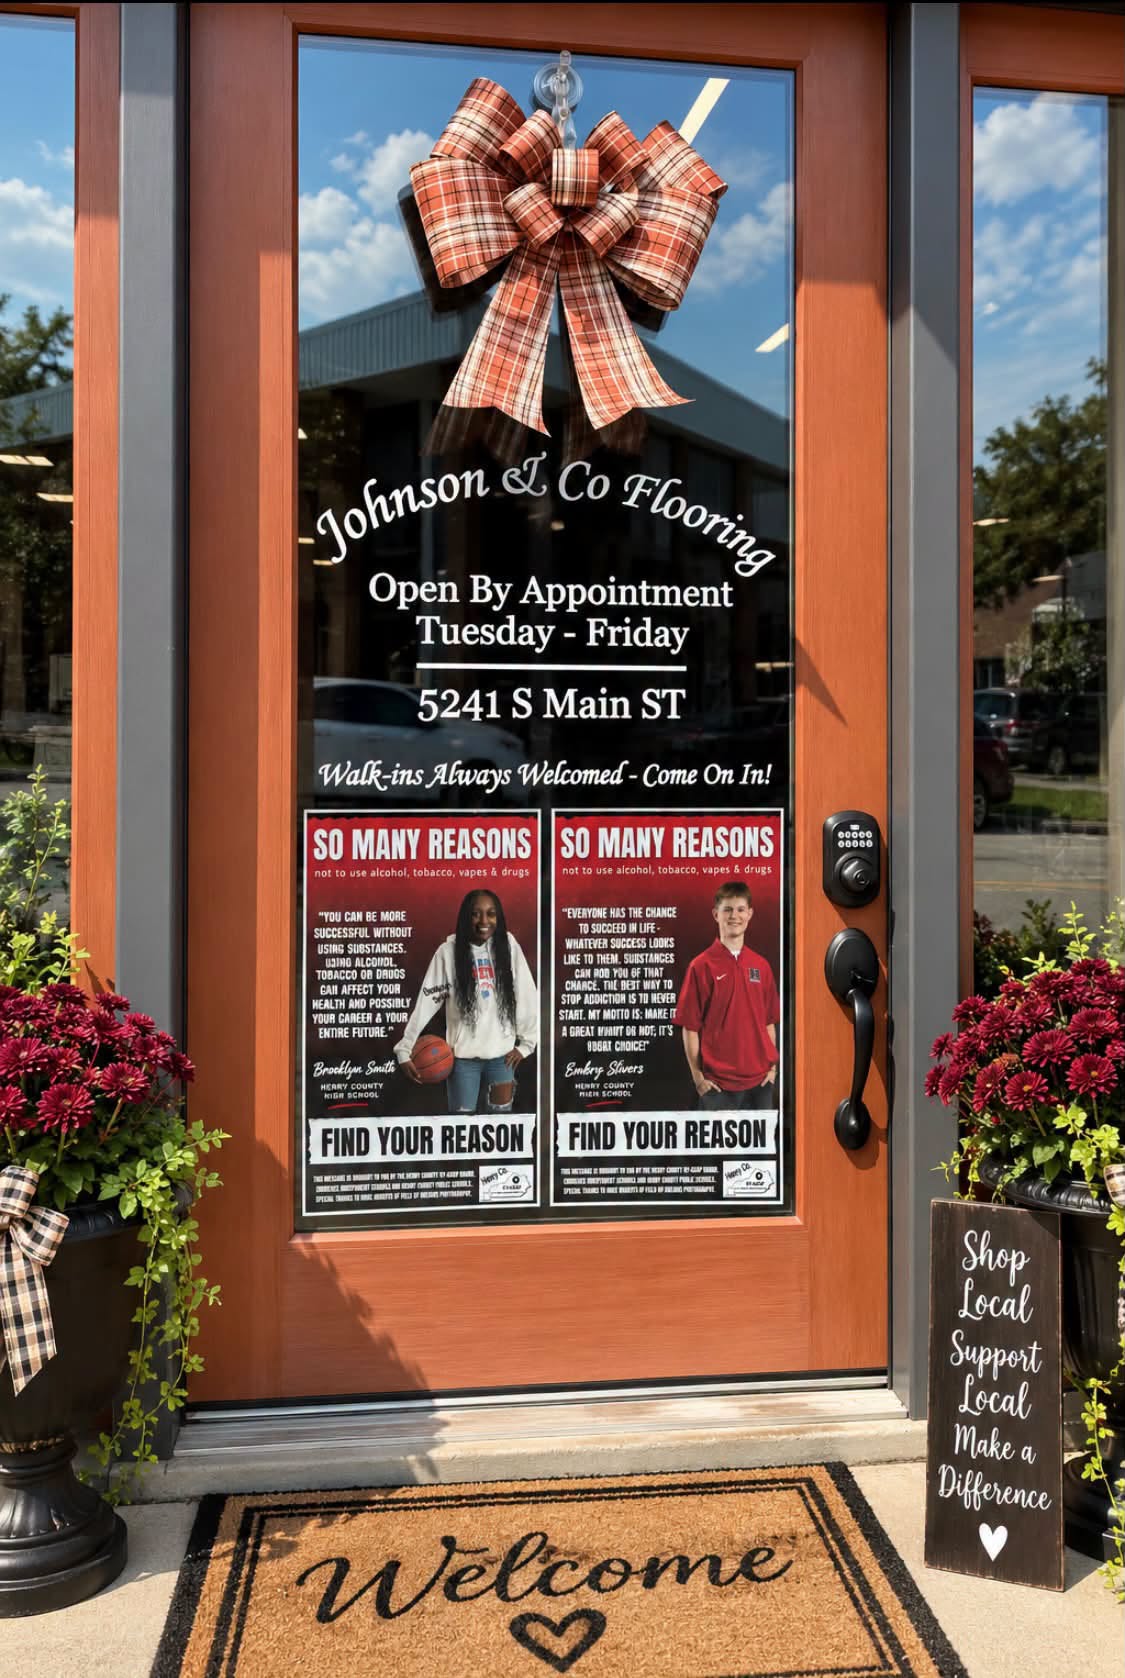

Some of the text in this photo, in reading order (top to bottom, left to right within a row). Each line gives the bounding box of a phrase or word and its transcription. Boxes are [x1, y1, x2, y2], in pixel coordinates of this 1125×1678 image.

[316, 451, 776, 578] Johnson & Co Flooring
[369, 572, 733, 612] Open By Appointment
[416, 616, 556, 653] Tuesday
[585, 618, 689, 654] Friday
[417, 688, 686, 722] 5241 S Main ST
[318, 761, 424, 788] Walk-ins
[426, 761, 512, 794] Always
[517, 761, 624, 786] Welcomed
[642, 764, 697, 787] Come
[702, 764, 734, 786] On
[738, 763, 773, 786] In!
[314, 828, 532, 860] SO MANY REASONS
[560, 826, 774, 859] SO MANY REASONS
[314, 867, 529, 880] not to use alcohol, tobacco, vapes & drugs
[562, 865, 772, 877] not to use alcohol, tobacco, vapes & drugs
[344, 911, 363, 923] CAN
[366, 911, 377, 923] BE
[380, 911, 406, 922] MORE
[610, 907, 626, 919] HAS
[628, 907, 643, 918] THE
[645, 906, 677, 918] CHANCE
[314, 926, 412, 939] SUCCESSFUL WITHOUT
[579, 923, 589, 934] TO
[591, 923, 627, 934] SUCCEED
[629, 923, 637, 934] IN
[639, 922, 656, 934] LIFE
[317, 943, 344, 955] USING
[565, 937, 675, 950] WHATEVER SUCCESS LOOKS
[563, 953, 675, 965] LIKE TO THEM. SUBSTANCES
[316, 969, 358, 981] TOBACCO
[574, 968, 591, 979] CAN
[612, 967, 629, 979] YOU
[644, 967, 664, 979] THAT
[341, 983, 374, 996] AFFECT
[377, 983, 401, 995] YOUR
[643, 980, 661, 991] WAY
[663, 979, 673, 991] TO
[312, 997, 411, 1010] HEALTH AND POSSIBLY
[561, 993, 676, 1006] STOP ADDICTION IS TO NEVER
[312, 1012, 409, 1025] YOUR CAREER & YOUR
[559, 1008, 586, 1021] START.
[588, 1008, 601, 1021] MY
[602, 1008, 630, 1020] MOTTO
[645, 1008, 668, 1020] MAKE
[670, 1008, 677, 1019] IT
[318, 1027, 350, 1039] ENTIRE
[562, 1026, 568, 1038] A
[570, 1026, 595, 1038] GREAT
[313, 1060, 398, 1080] Brooklyn Smith
[565, 1060, 604, 1080] Embry
[350, 1082, 384, 1091] COUNTY
[603, 1082, 634, 1090] COUNTY
[602, 1090, 632, 1098] SCHOOL
[321, 1123, 524, 1158] FIND YOUR REASON
[569, 1119, 767, 1151] FIND YOUR REASON
[962, 1229, 1031, 1288] Shop
[958, 1278, 1034, 1324] Local
[950, 1328, 1043, 1380] Support
[958, 1373, 1033, 1420] Local
[953, 1423, 1037, 1465] Make a
[938, 1463, 1053, 1512] Difference
[296, 1531, 794, 1624] Welcome
